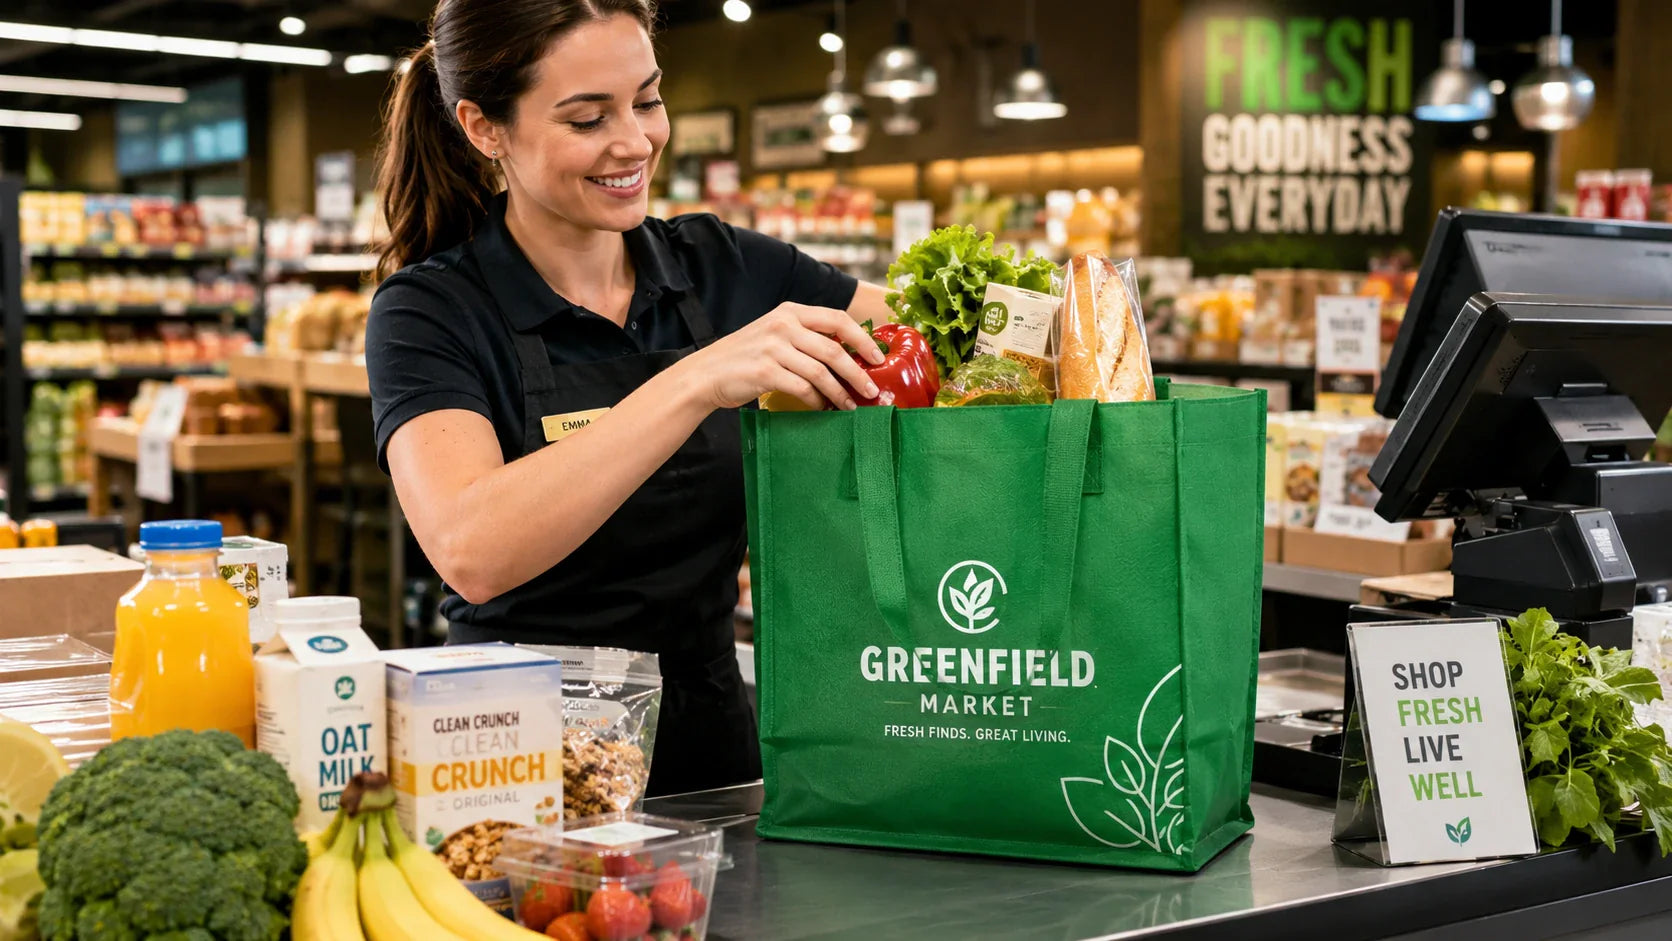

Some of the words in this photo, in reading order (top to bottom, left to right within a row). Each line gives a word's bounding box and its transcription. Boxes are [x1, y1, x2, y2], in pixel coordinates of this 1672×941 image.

[1205, 17, 1412, 111] FRESH
[1203, 113, 1413, 174] GOODNESS
[1203, 175, 1411, 234] EVERYDAY
[860, 645, 1096, 688] GREENFIELD
[1392, 661, 1463, 690] SHOP
[920, 693, 1033, 717] MARKET
[1397, 697, 1483, 727] FRESH
[433, 716, 471, 734] CLEAN
[474, 711, 520, 730] CRUNCH
[884, 725, 925, 738] FRESH
[929, 726, 971, 740] FINDS.
[975, 728, 1018, 741] GREAT
[1022, 730, 1071, 743] LIVING.
[321, 723, 372, 756] OAT
[1403, 734, 1463, 763] LIVE
[431, 752, 546, 794] CRUNCH
[1408, 771, 1483, 801] WELL
[453, 791, 521, 811] ORIGINAL
